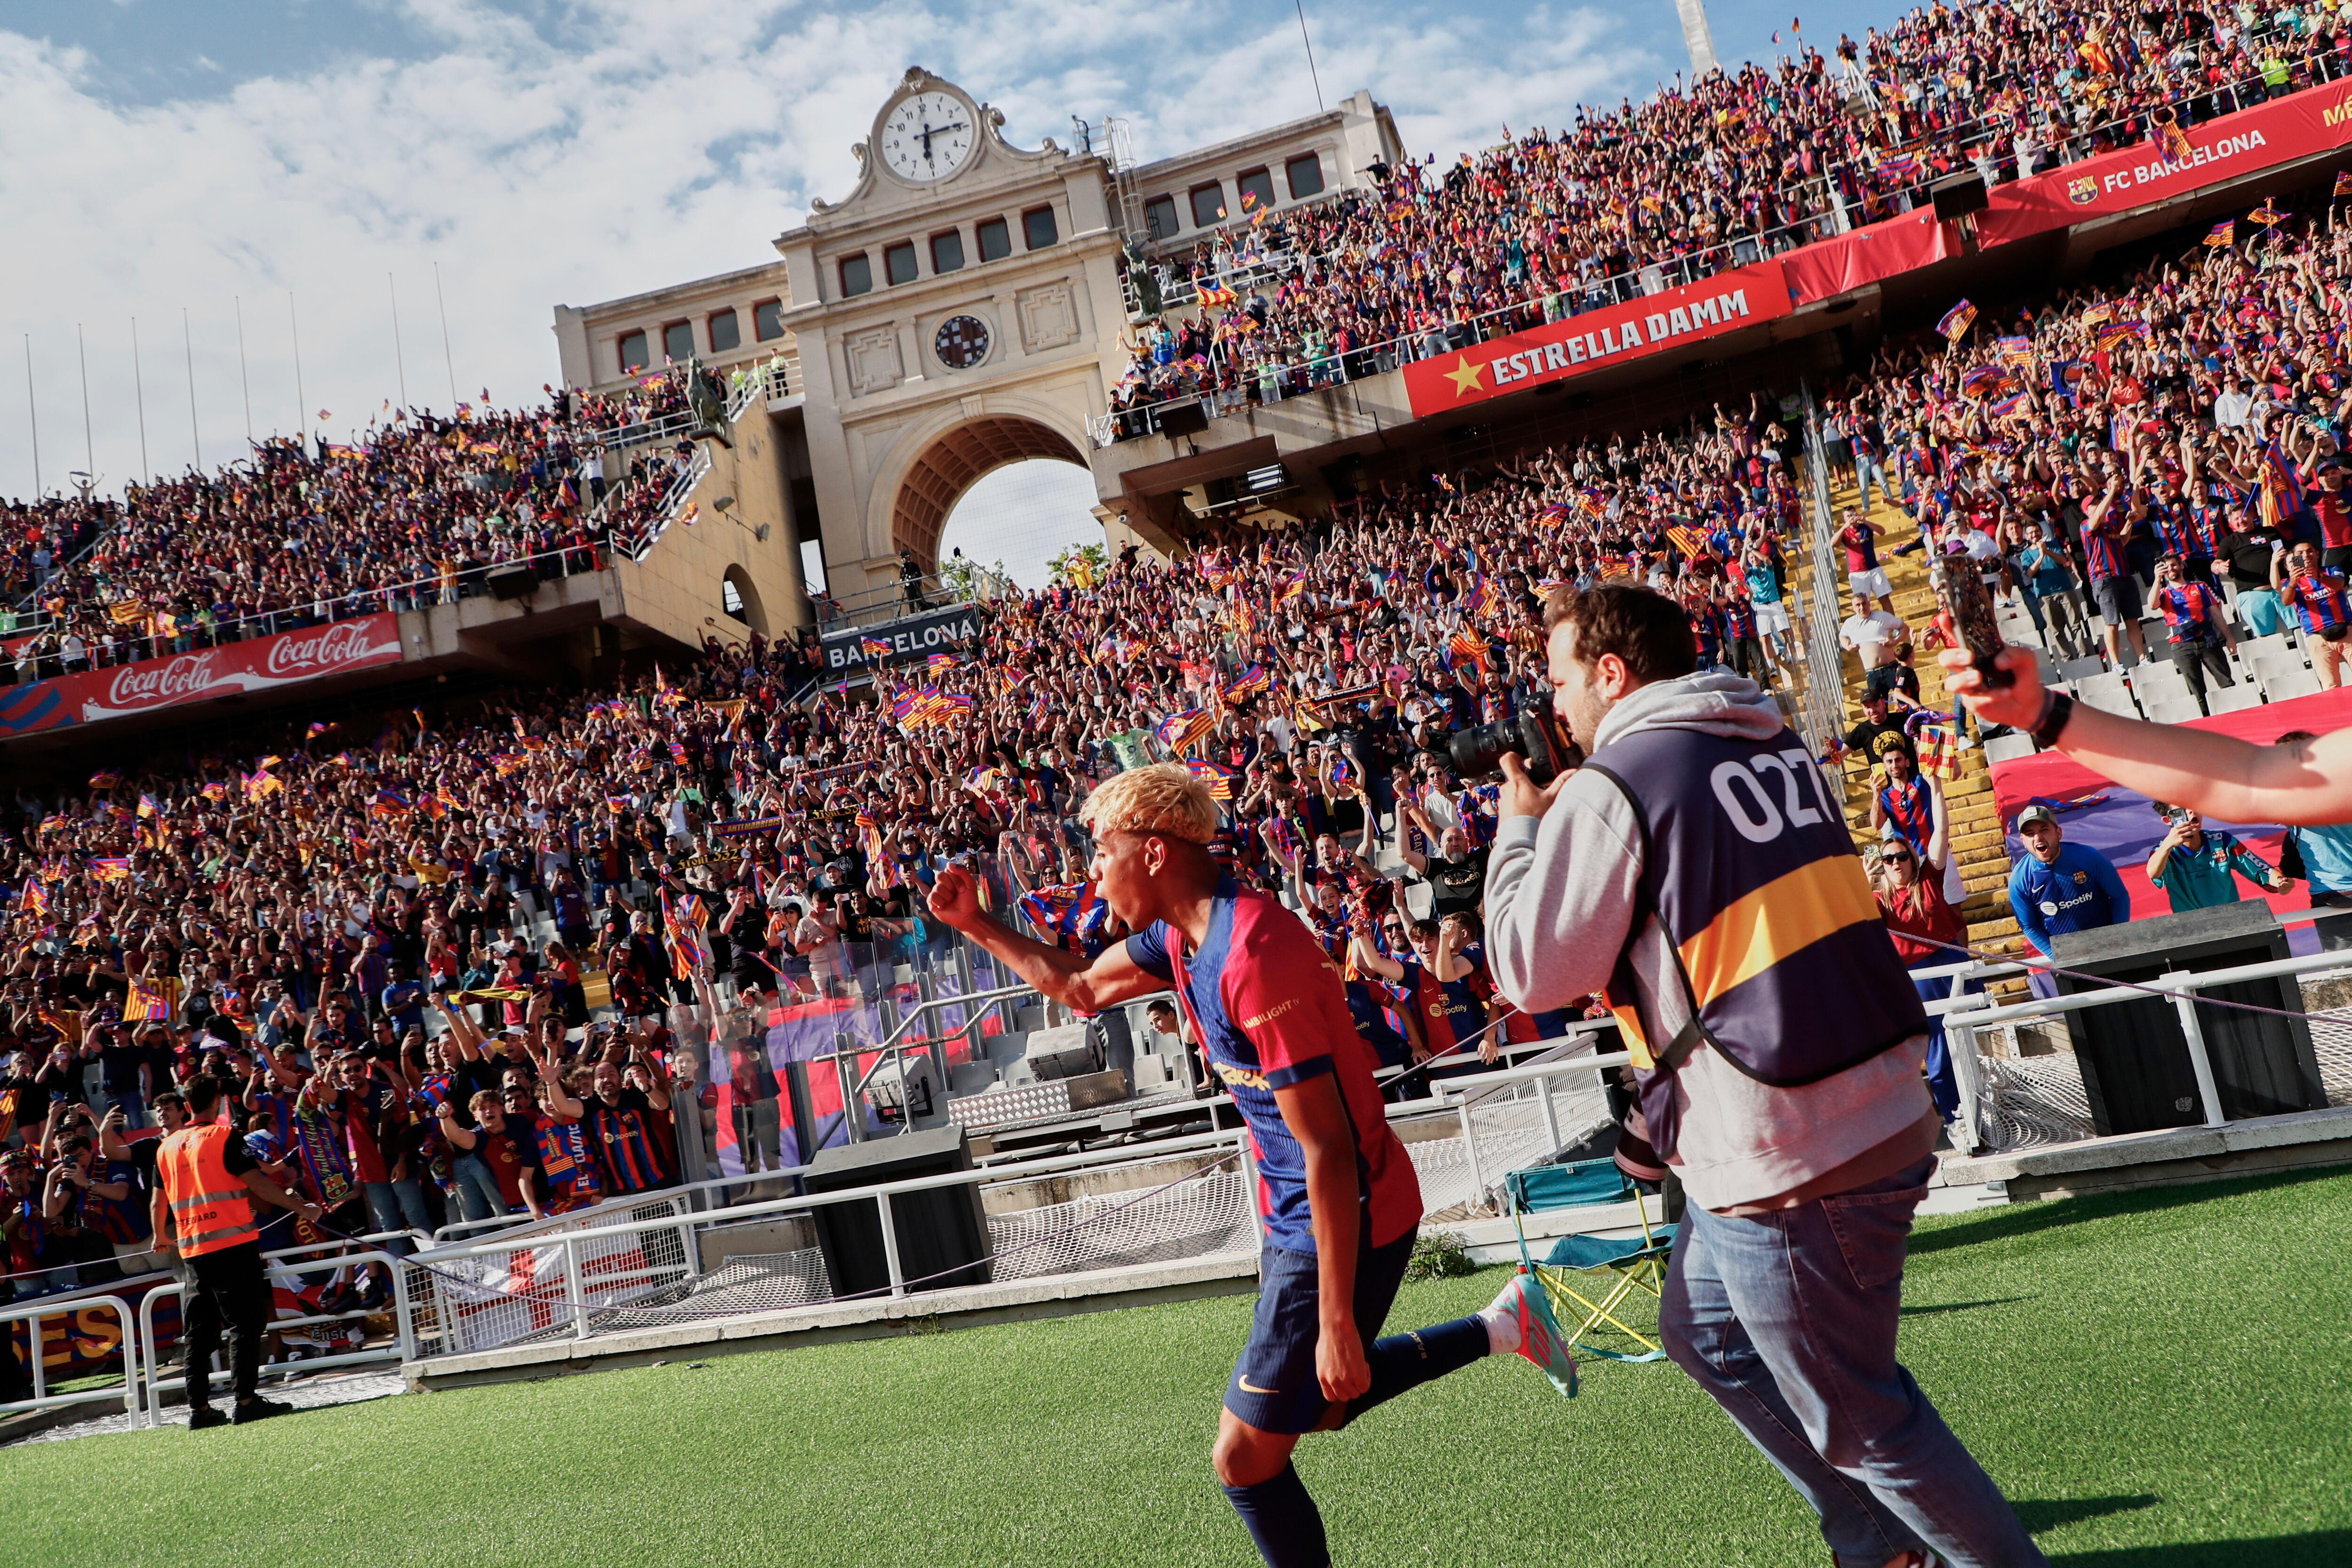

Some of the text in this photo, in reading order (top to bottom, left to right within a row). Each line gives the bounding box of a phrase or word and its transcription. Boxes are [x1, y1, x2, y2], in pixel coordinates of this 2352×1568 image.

[919, 103, 926, 113] 12
[937, 103, 940, 112] 1
[906, 111, 913, 120] 11
[948, 110, 954, 118] 2
[897, 123, 905, 132] 10
[894, 140, 899, 149] 9
[901, 153, 906, 162] 8
[945, 151, 950, 160] 5
[912, 159, 917, 168] 7
[930, 160, 935, 169] 6
[2104, 171, 2131, 193] FC
[1491, 289, 1749, 385] ESTRELLA DAMM
[1324, 606, 1346, 616] SECCIONS
[268, 621, 371, 673] Coca-Cola
[110, 651, 217, 704] Coca-Cola
[1710, 748, 1835, 843] 027
[728, 818, 781, 832] ANTIMADRIDIS
[2058, 892, 2093, 909] Spotify
[1243, 1000, 1291, 1029] AMBILIGHT
[1441, 1004, 1467, 1015] Spotify
[614, 1129, 639, 1140] Spotify
[578, 1174, 589, 1187] EL
[176, 1211, 218, 1227] STEWARD
